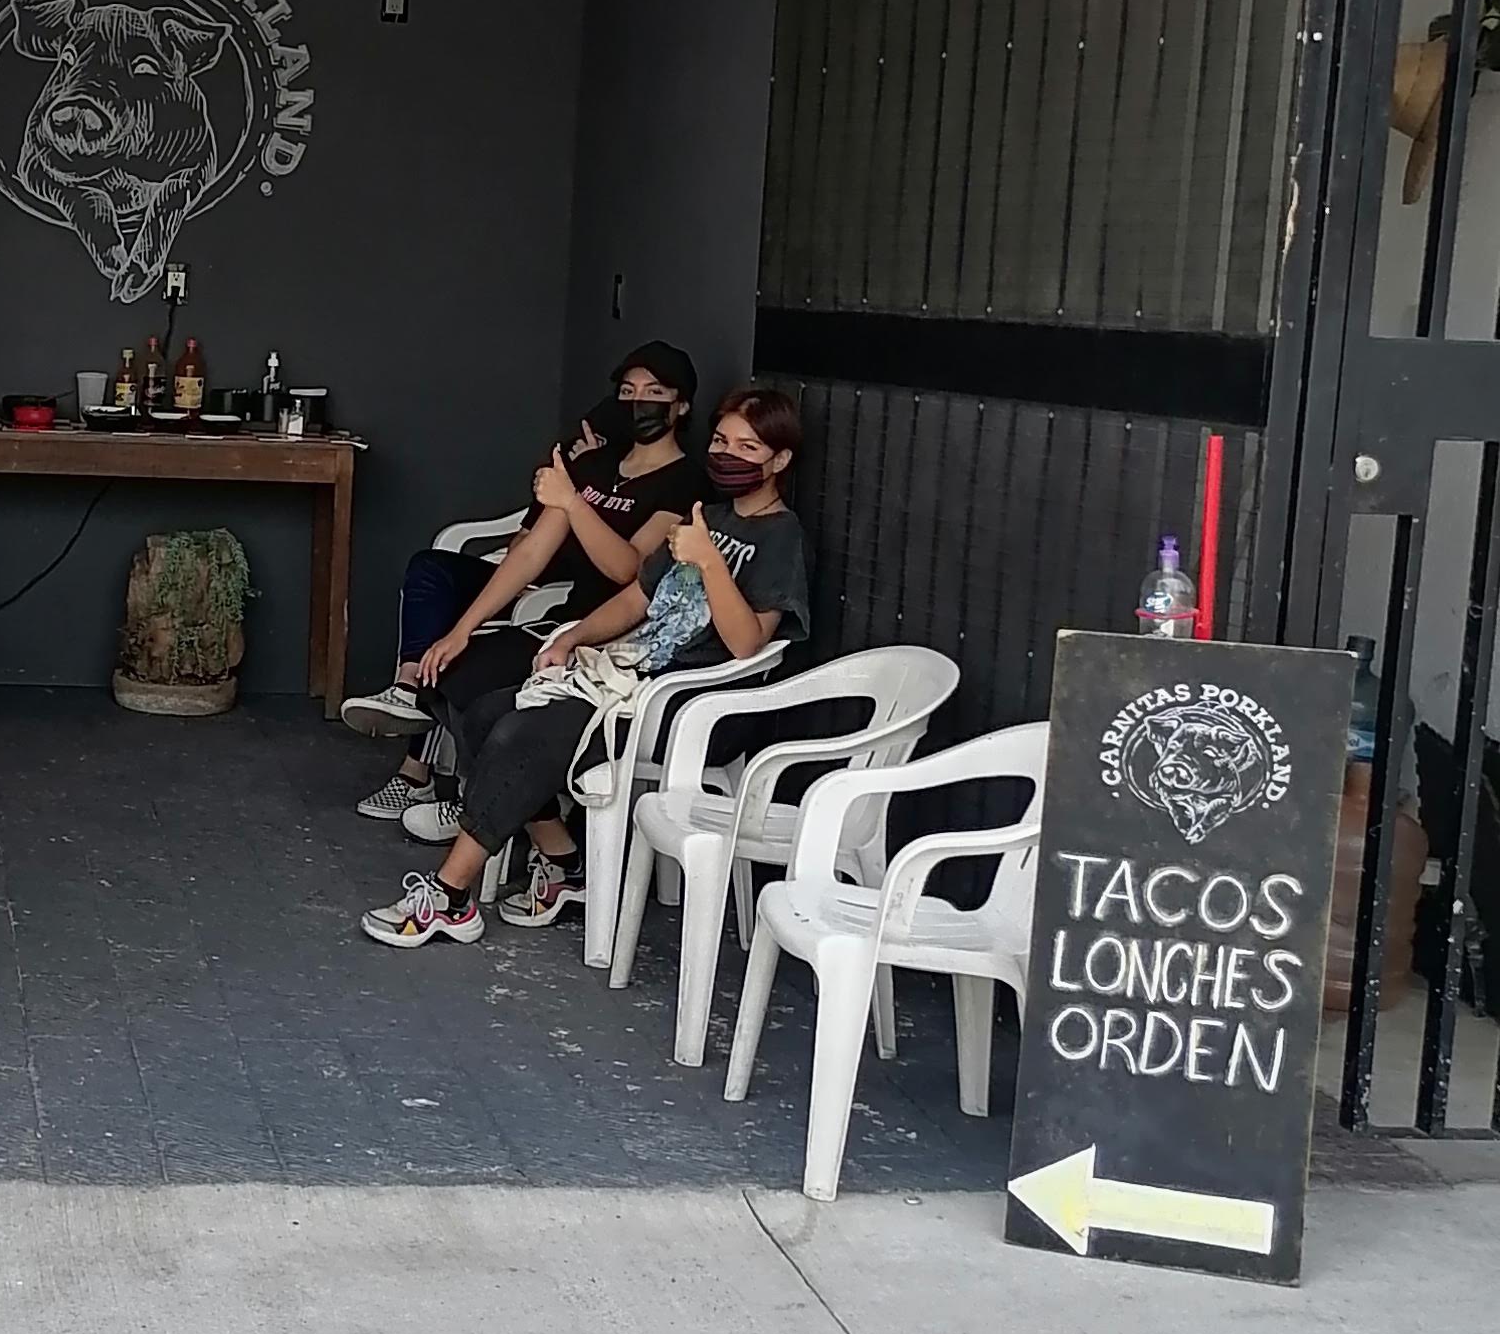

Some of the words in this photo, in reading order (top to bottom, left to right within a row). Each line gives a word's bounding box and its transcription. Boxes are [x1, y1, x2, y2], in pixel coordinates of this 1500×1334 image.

[603, 496, 635, 512] BYE
[1100, 684, 1191, 786] CARNITAS
[1199, 684, 1291, 802] PORKLAND
[1057, 851, 1304, 939] TACOS
[1049, 929, 1303, 1011] LONCHES
[1050, 1006, 1285, 1093] ORDEN
